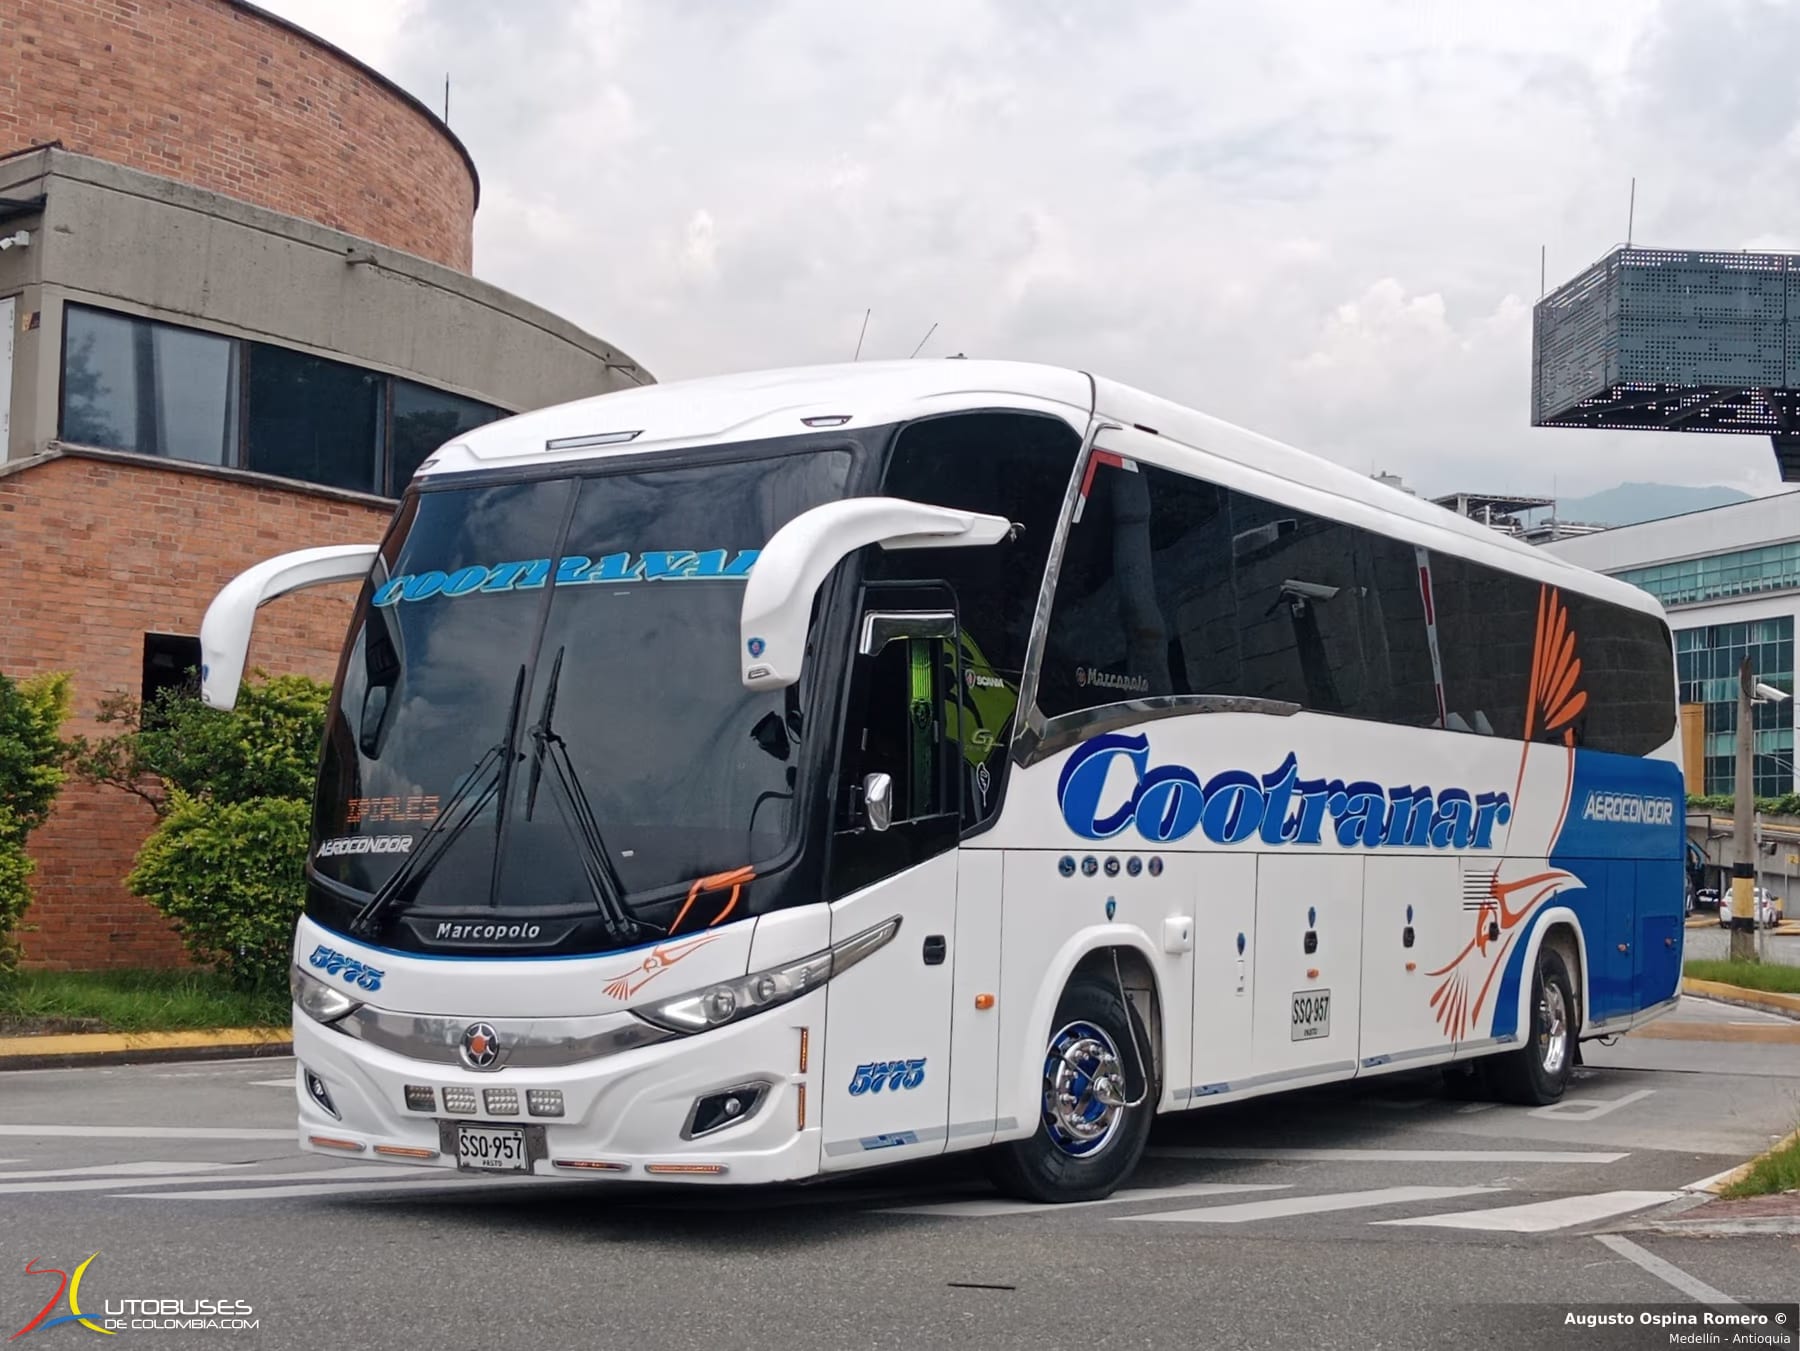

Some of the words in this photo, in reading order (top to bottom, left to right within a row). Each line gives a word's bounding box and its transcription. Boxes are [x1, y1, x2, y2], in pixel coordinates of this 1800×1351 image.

[976, 675, 1004, 688] SCANIA
[1057, 732, 1511, 849] Cootranar
[1582, 790, 1673, 825] AEROCONDOR
[315, 835, 413, 858] AEROCONDOR
[436, 922, 541, 940] Marcopolo
[309, 944, 385, 992] 5775
[848, 1057, 927, 1097] 5775
